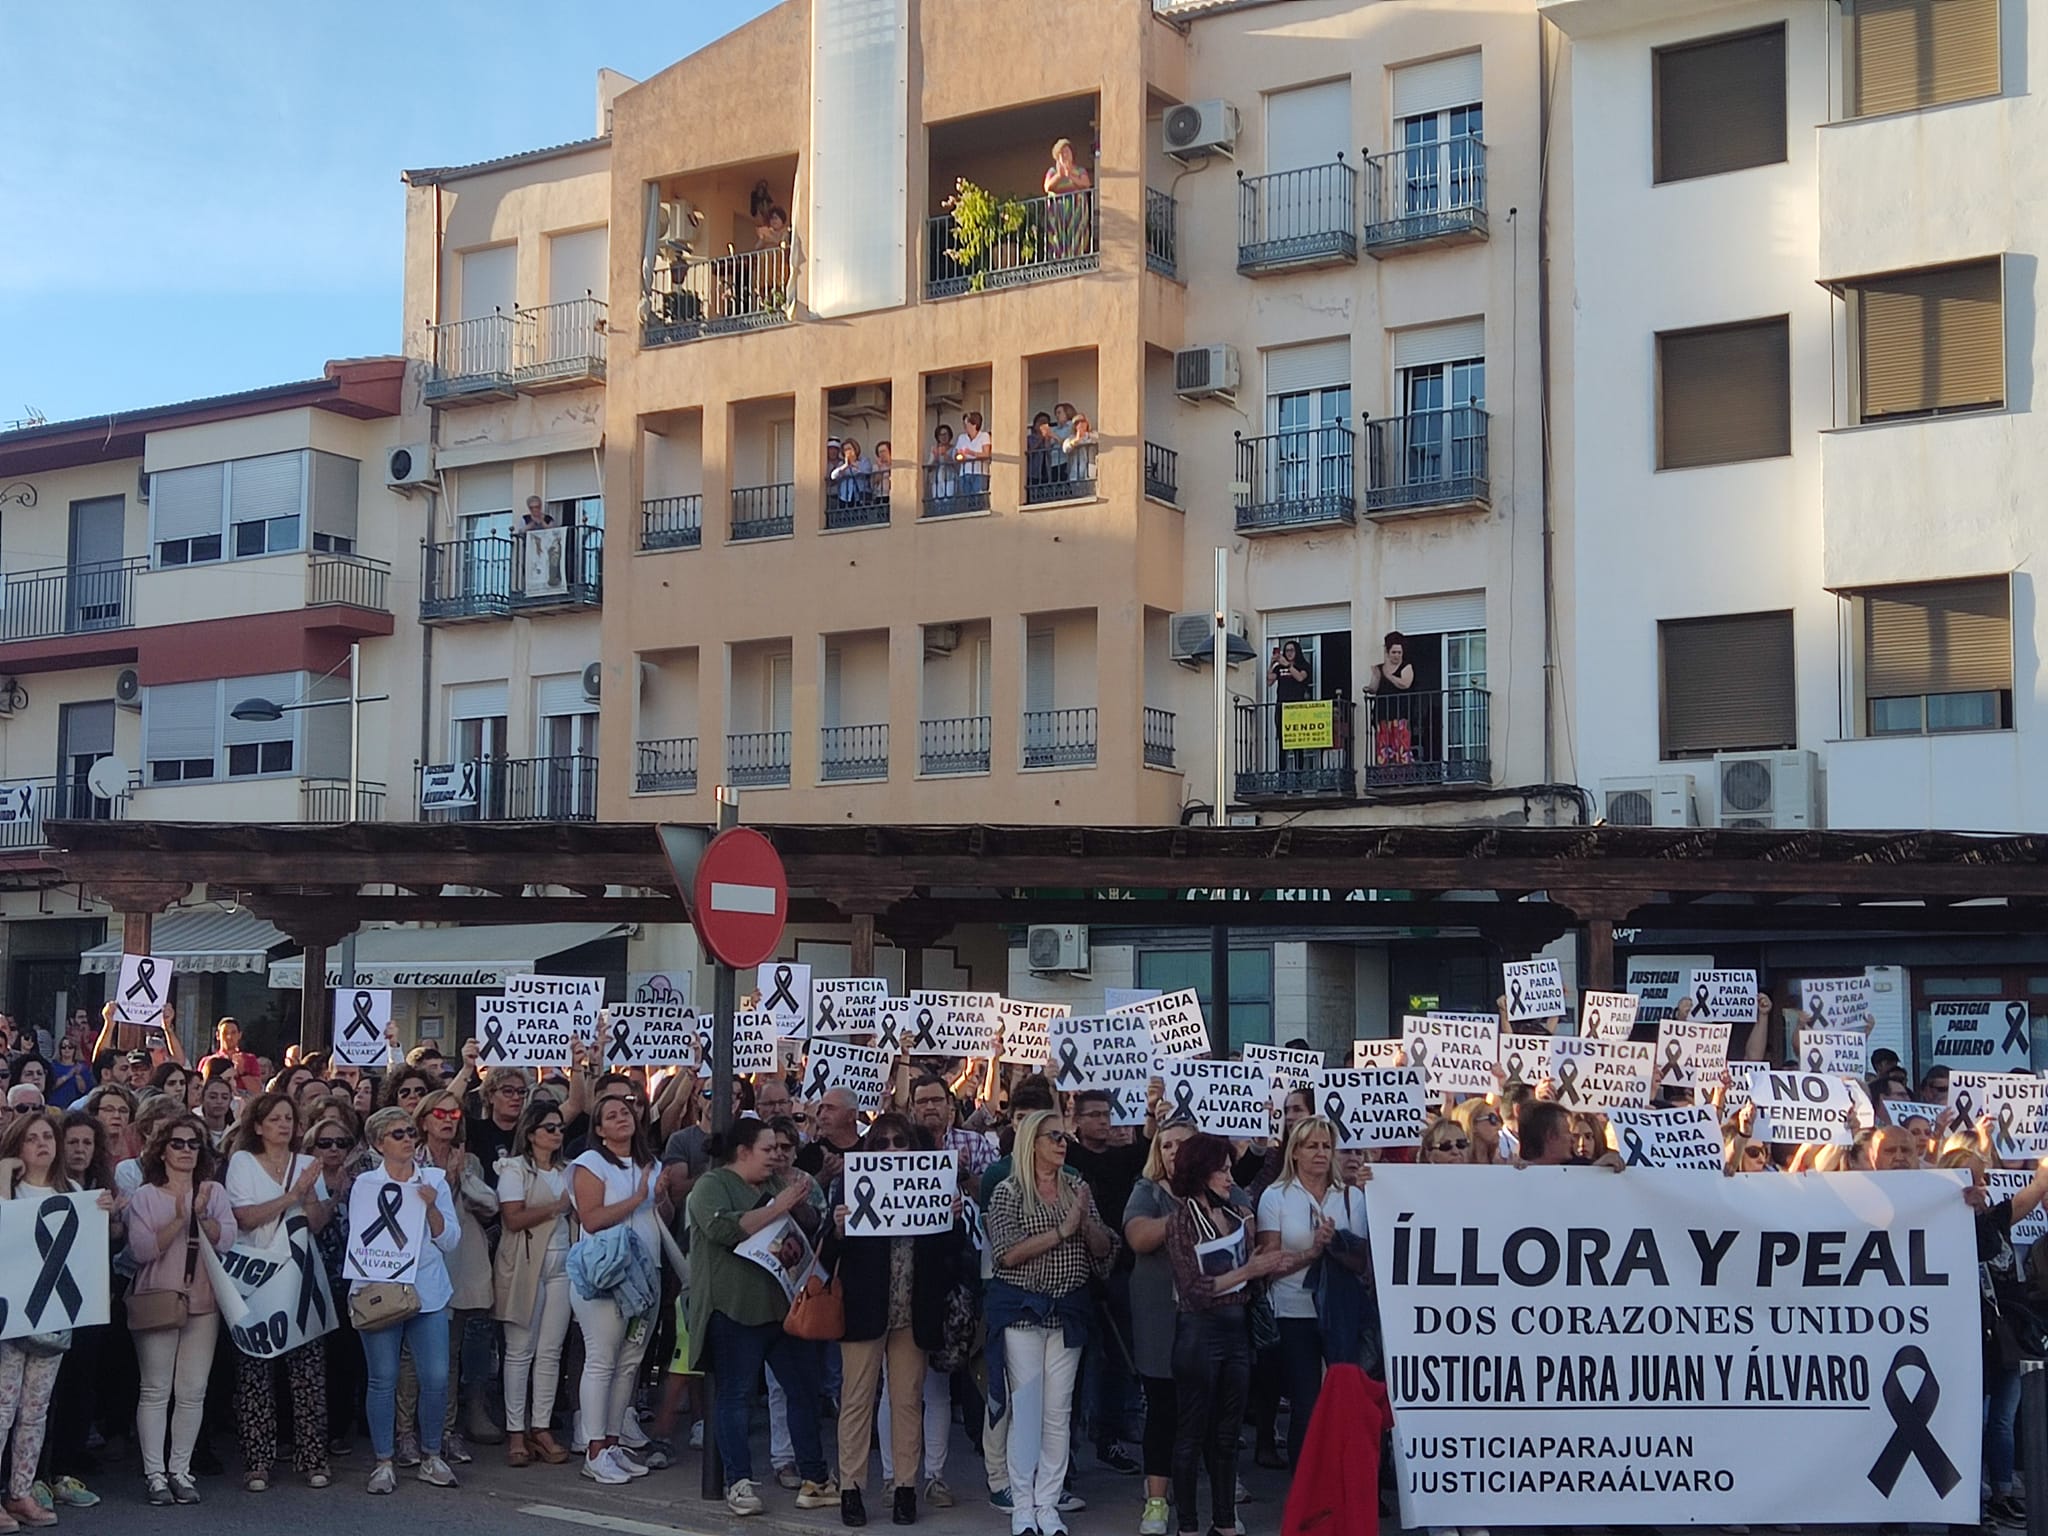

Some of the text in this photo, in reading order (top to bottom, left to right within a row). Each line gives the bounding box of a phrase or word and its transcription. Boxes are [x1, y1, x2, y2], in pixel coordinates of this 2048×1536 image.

[1284, 722, 1325, 732] VENDO
[1506, 961, 1557, 977] JUSTICIA
[394, 969, 497, 986] artesanales
[1529, 976, 1556, 988] PARA
[1629, 970, 1680, 985] JUSTICIA
[1693, 971, 1754, 983] JUSTICIA
[509, 980, 592, 996] JUSTICIA
[816, 980, 885, 993] JUSTICIA
[1719, 985, 1748, 995] PARA
[1806, 978, 1872, 993] JUSTICIA
[913, 993, 995, 1009] JUSTICIA
[1640, 987, 1669, 1000] PARA
[1835, 992, 1865, 1004] PARA
[480, 1000, 569, 1014] JUSTICIA
[1526, 1001, 1562, 1013] Y JUAN
[1587, 995, 1636, 1009] JUSTICIA
[1934, 1002, 1992, 1017] JUSTICIA
[611, 1005, 695, 1019] JUSTICIA
[947, 1011, 985, 1024] PARA
[1712, 1008, 1753, 1018] Y JUAN
[517, 1018, 560, 1030] PARA
[644, 1021, 684, 1032] PARA
[838, 1018, 876, 1030] Y JUA
[1053, 1016, 1145, 1036] JUSTICIA
[1149, 1010, 1188, 1031] PARA
[1830, 1018, 1837, 1027] Y
[1946, 1019, 1979, 1032] PARA
[936, 1023, 994, 1037] ÁLVARO
[1408, 1020, 1492, 1041] JUSTICIA
[1663, 1023, 1728, 1039] JUSTICIA
[506, 1030, 570, 1046] ÁLVARO
[632, 1033, 692, 1046] ÁLVARO
[937, 1039, 990, 1051] Y JUAN
[1093, 1036, 1136, 1050] PARA
[1803, 1033, 1864, 1048] JUSTICIA
[1008, 1046, 1017, 1058] Y
[1441, 1041, 1482, 1056] PARA
[1555, 1041, 1650, 1060] JUSTICIA
[1695, 1042, 1722, 1054] PARA
[1934, 1035, 1996, 1057] ÁLVARO
[509, 1048, 567, 1061] Y JUAN
[635, 1048, 690, 1060] Y JUAN
[812, 1043, 890, 1065] JUSTICIA
[1083, 1048, 1148, 1067] ÁLVARO
[1247, 1047, 1320, 1066] JUSTICIA
[1834, 1049, 1860, 1061] PARA
[843, 1064, 879, 1079] PARA
[1085, 1067, 1148, 1083] Y JUAN
[1170, 1062, 1264, 1081] JUSTICIA
[1276, 1065, 1310, 1078] PARA
[1594, 1062, 1637, 1077] PARA
[1683, 1071, 1694, 1082] Y
[1318, 1070, 1420, 1089] JUSTICIA
[1434, 1072, 1492, 1087] Y JUAN
[1581, 1075, 1647, 1093] ÁLVARO
[1209, 1083, 1254, 1097] PARA
[1769, 1073, 1831, 1104] NO
[1361, 1091, 1409, 1106] PARA
[1582, 1093, 1644, 1109] Y JUAN
[1350, 1106, 1422, 1124] ÁLVARO
[1614, 1108, 1712, 1128] JUSTICIA
[1757, 1104, 1849, 1124] TENEMOS
[1200, 1117, 1212, 1129] Y
[1216, 1117, 1262, 1130] JUAN
[1352, 1125, 1420, 1141] Y JUAN
[1655, 1128, 1705, 1144] PARA
[1771, 1124, 1833, 1142] MIEDO
[1650, 1142, 1721, 1159] ÁLVARO
[2016, 1139, 2026, 1152] Y
[849, 1154, 953, 1173] JUSTICIA
[893, 1176, 942, 1192] PARA
[880, 1192, 952, 1210] ÁLVARO
[883, 1211, 949, 1228] Y JUAN
[1391, 1212, 1949, 1287] ÍLLORA Y PEAL
[1413, 1305, 1930, 1335] DOS CORAZONES UNIDOS
[1391, 1345, 1870, 1403] JUSTICIA PARA JUAN Y ÁLVARO
[1405, 1435, 1694, 1460] JUSTICIAPARAJUAN
[1410, 1464, 1735, 1494] JUSTICIAPARAÁLVARO
